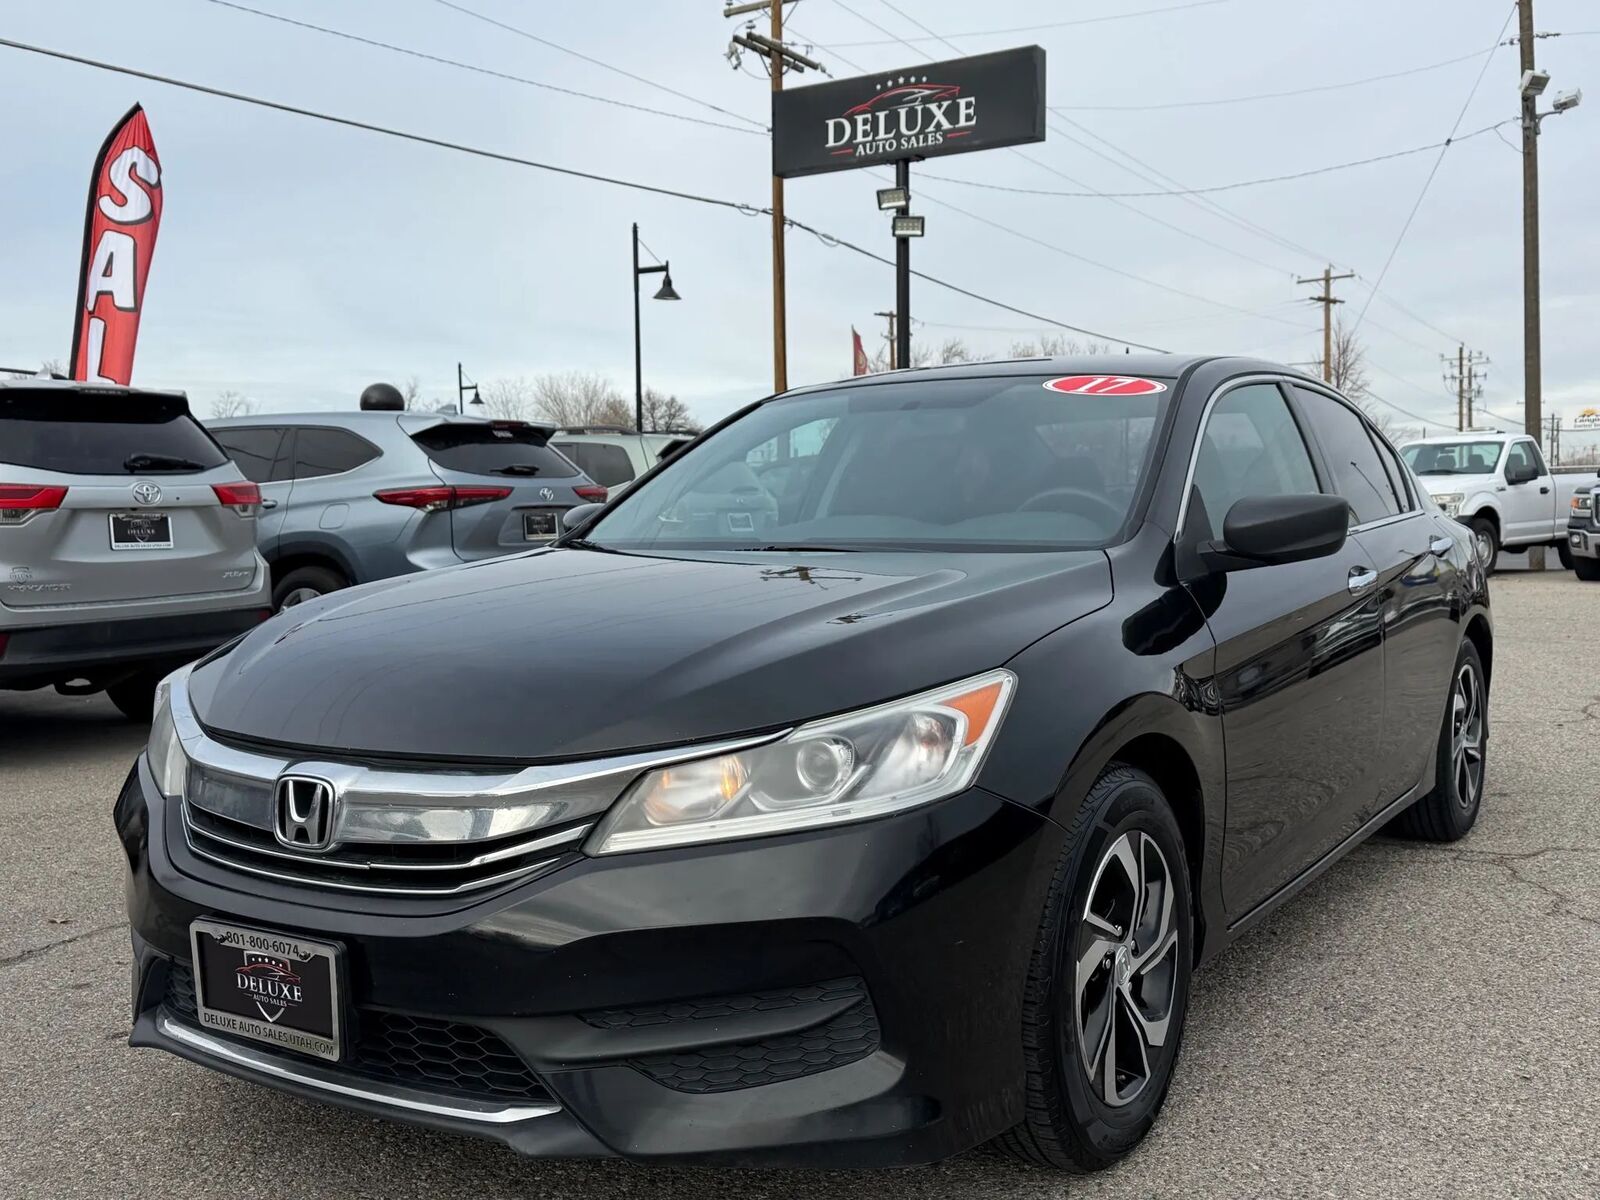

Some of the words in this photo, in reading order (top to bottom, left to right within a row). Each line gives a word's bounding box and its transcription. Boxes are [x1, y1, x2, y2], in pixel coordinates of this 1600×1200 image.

[825, 96, 977, 148] DELUXE
[855, 137, 897, 157] AUTO
[900, 131, 944, 150] SALES
[1070, 377, 1139, 393] 17
[226, 931, 299, 957] 801-800-6074
[237, 973, 303, 1002] DELUXE
[253, 994, 269, 1004] AUTO
[269, 996, 288, 1007] SALES
[204, 1012, 237, 1030] DELUXE
[238, 1020, 262, 1036] AUTO
[263, 1027, 288, 1043] SALES
